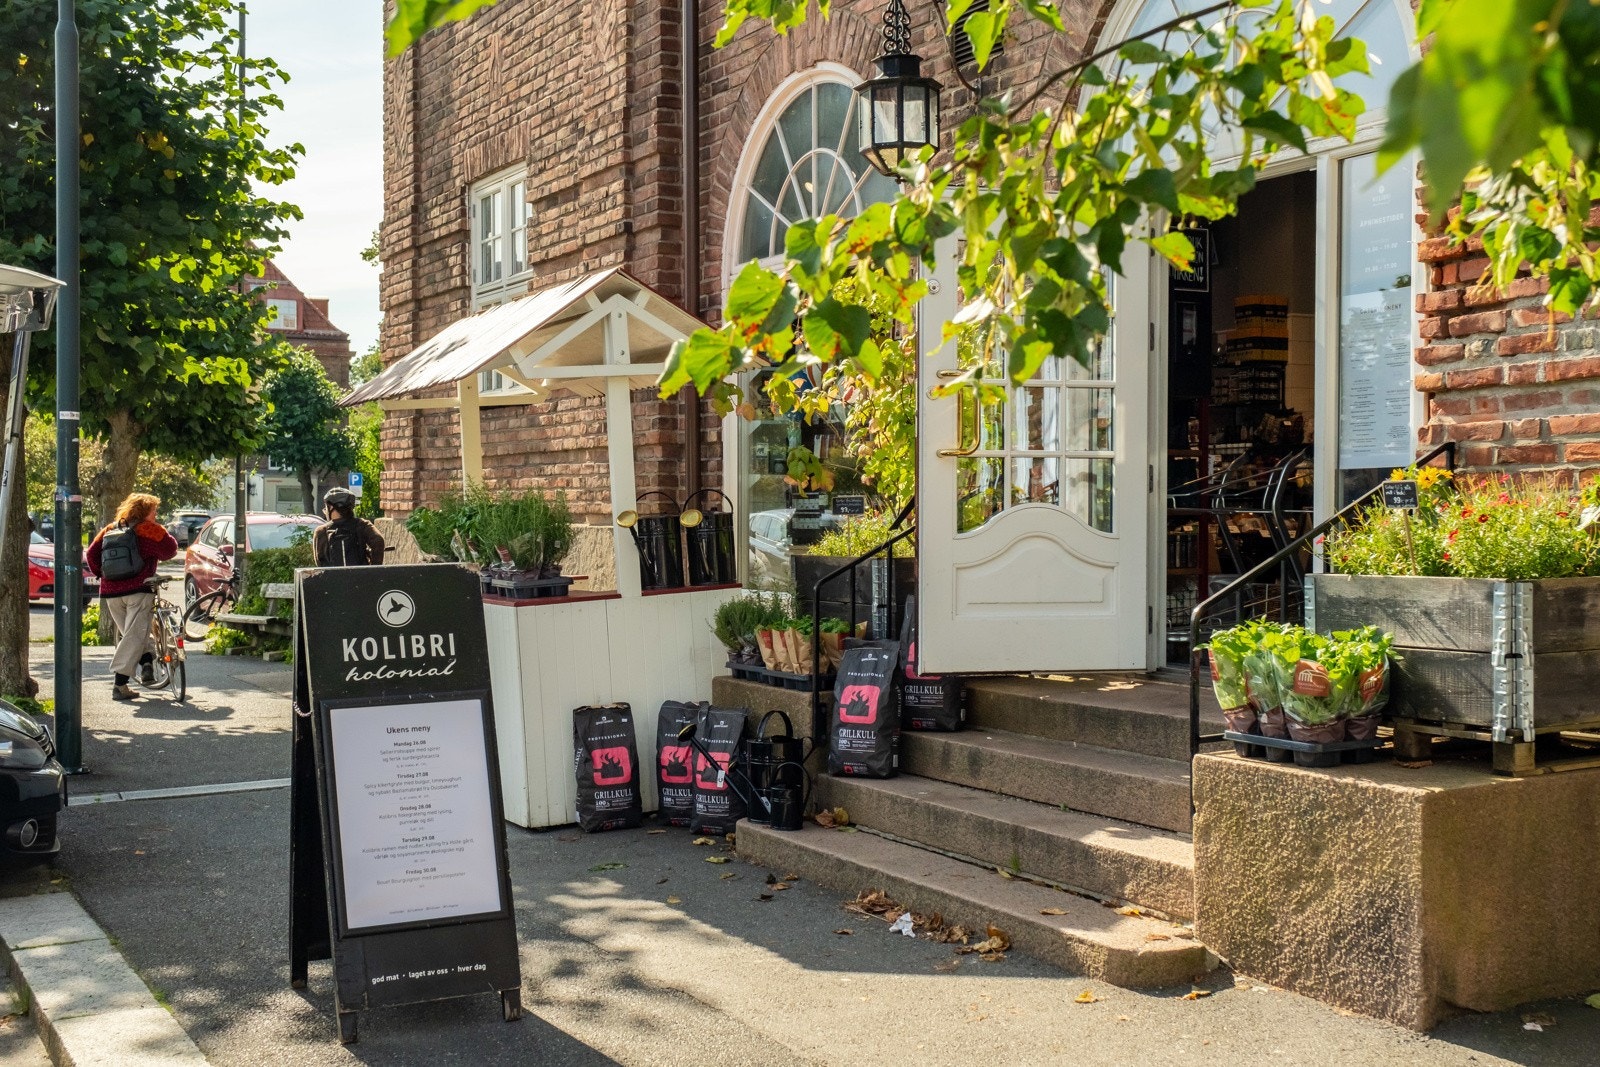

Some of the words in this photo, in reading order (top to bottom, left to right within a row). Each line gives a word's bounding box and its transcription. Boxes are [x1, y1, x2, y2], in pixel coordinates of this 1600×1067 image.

[352, 474, 359, 485] P
[342, 633, 456, 662] KOLIBRI
[346, 658, 457, 682] kolonial
[905, 684, 944, 694] GRILLKULL
[411, 725, 431, 734] meny
[838, 728, 876, 740] GRILLKULL
[588, 733, 626, 741] PROFESSIONAL
[594, 788, 634, 799] GRILLKULL
[663, 788, 692, 797] GRILLKUL
[696, 794, 729, 804] GRILLKULL
[371, 976, 384, 984] god
[386, 974, 399, 982] mat
